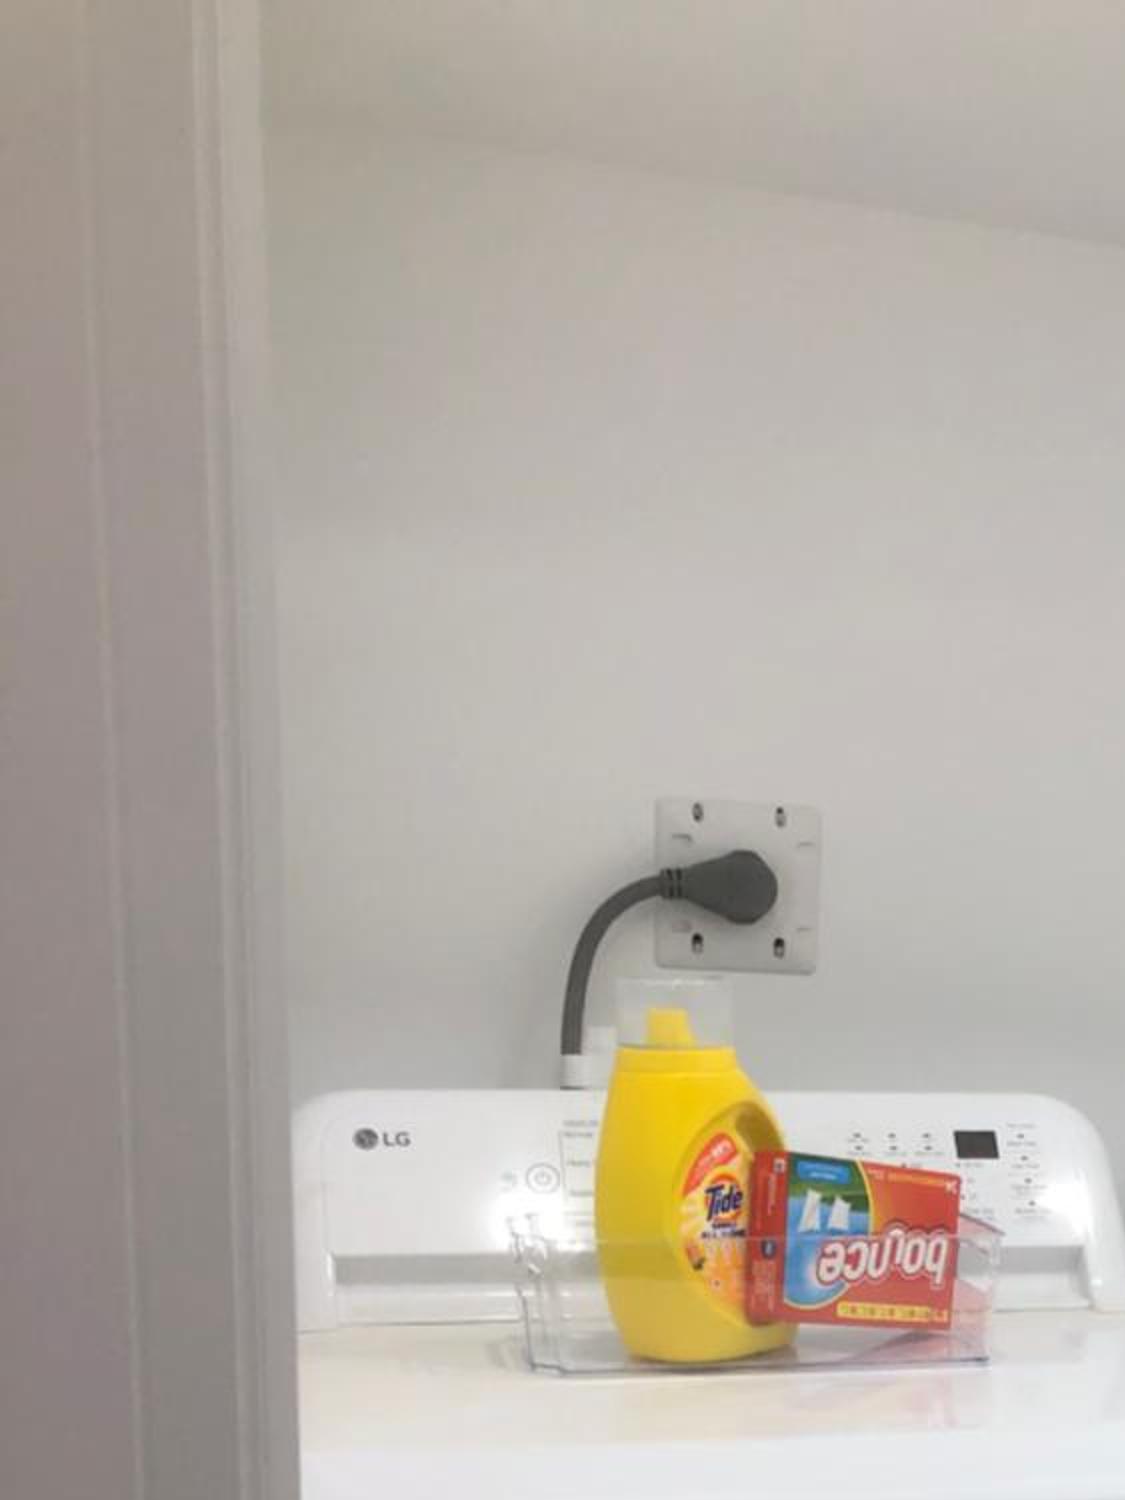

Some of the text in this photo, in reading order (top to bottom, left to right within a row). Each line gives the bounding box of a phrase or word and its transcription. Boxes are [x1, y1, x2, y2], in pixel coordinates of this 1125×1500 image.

[382, 1131, 412, 1147] LG
[704, 1183, 744, 1222] Tide
[816, 1226, 950, 1287] bounce
